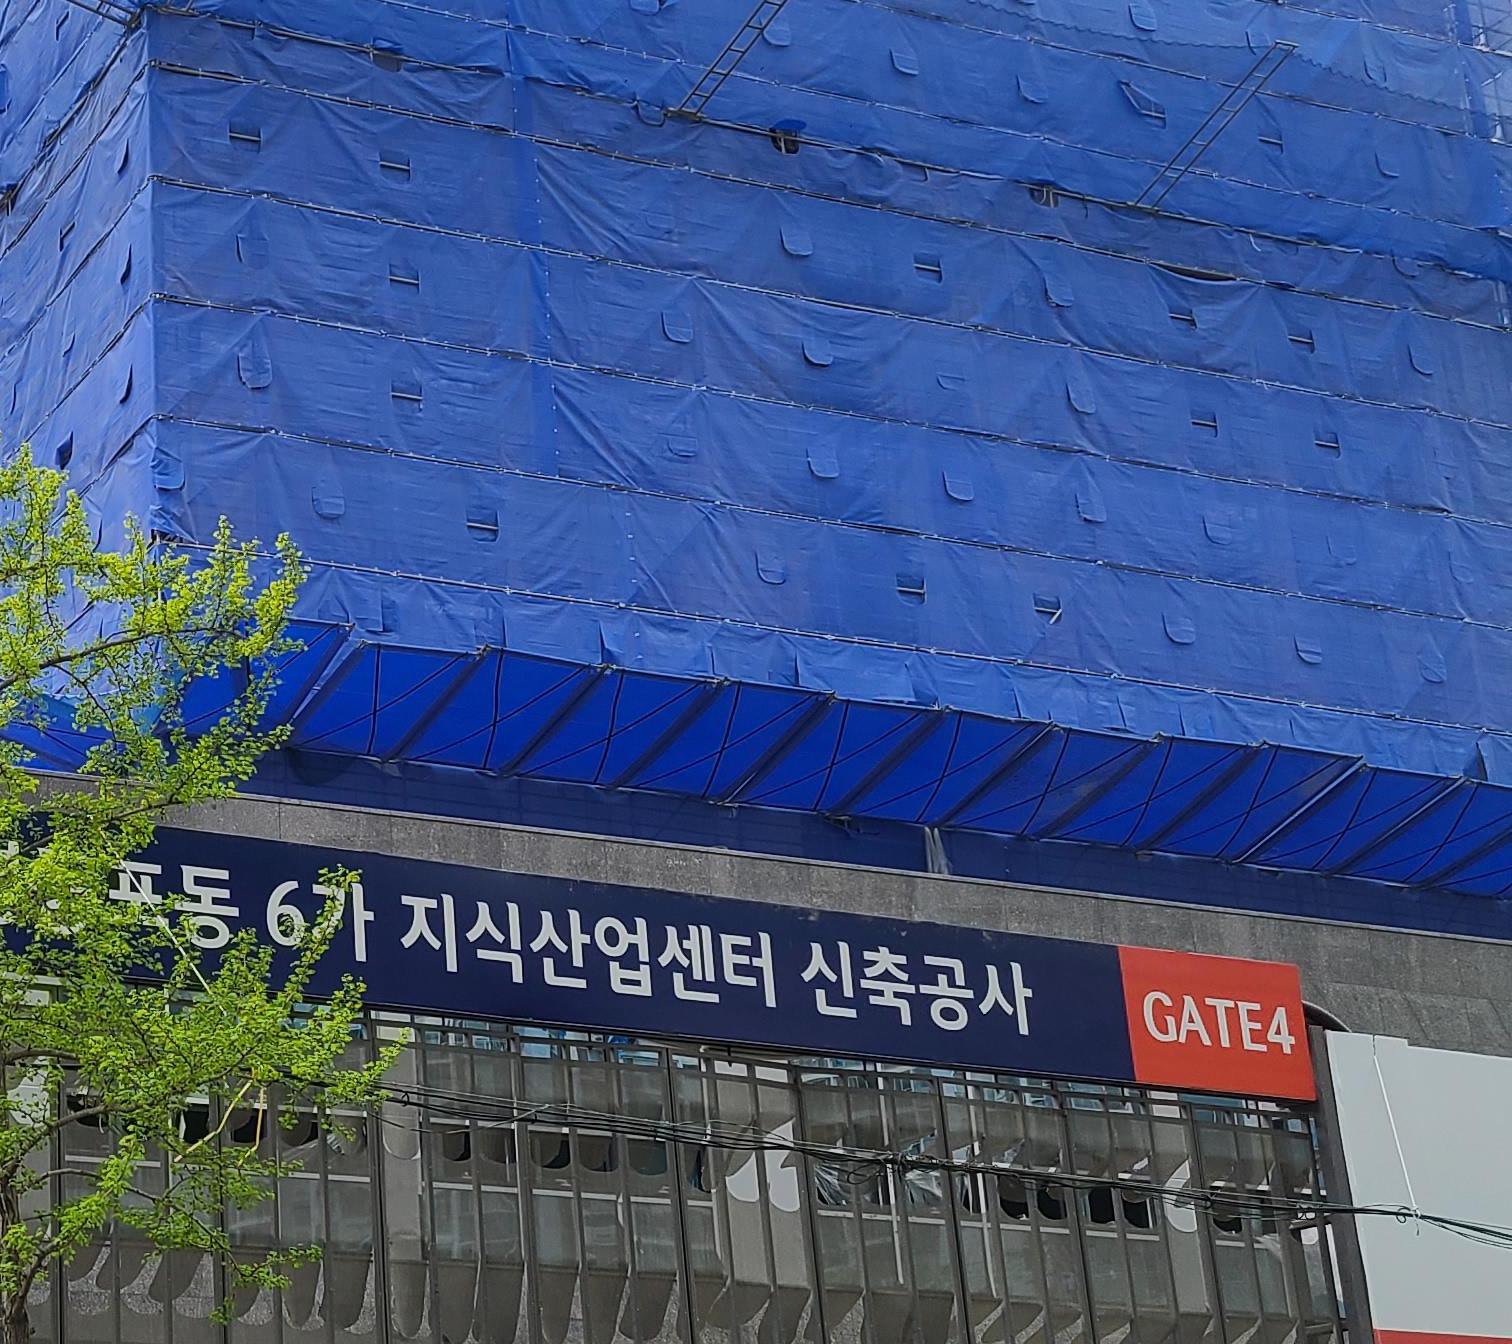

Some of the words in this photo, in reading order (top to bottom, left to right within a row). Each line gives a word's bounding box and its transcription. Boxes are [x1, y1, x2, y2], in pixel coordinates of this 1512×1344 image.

[266, 880, 375, 962] 6가
[399, 893, 777, 1008] 지식산업센터
[800, 940, 1033, 1036] 신축공사
[1143, 991, 1296, 1055] GATE4
